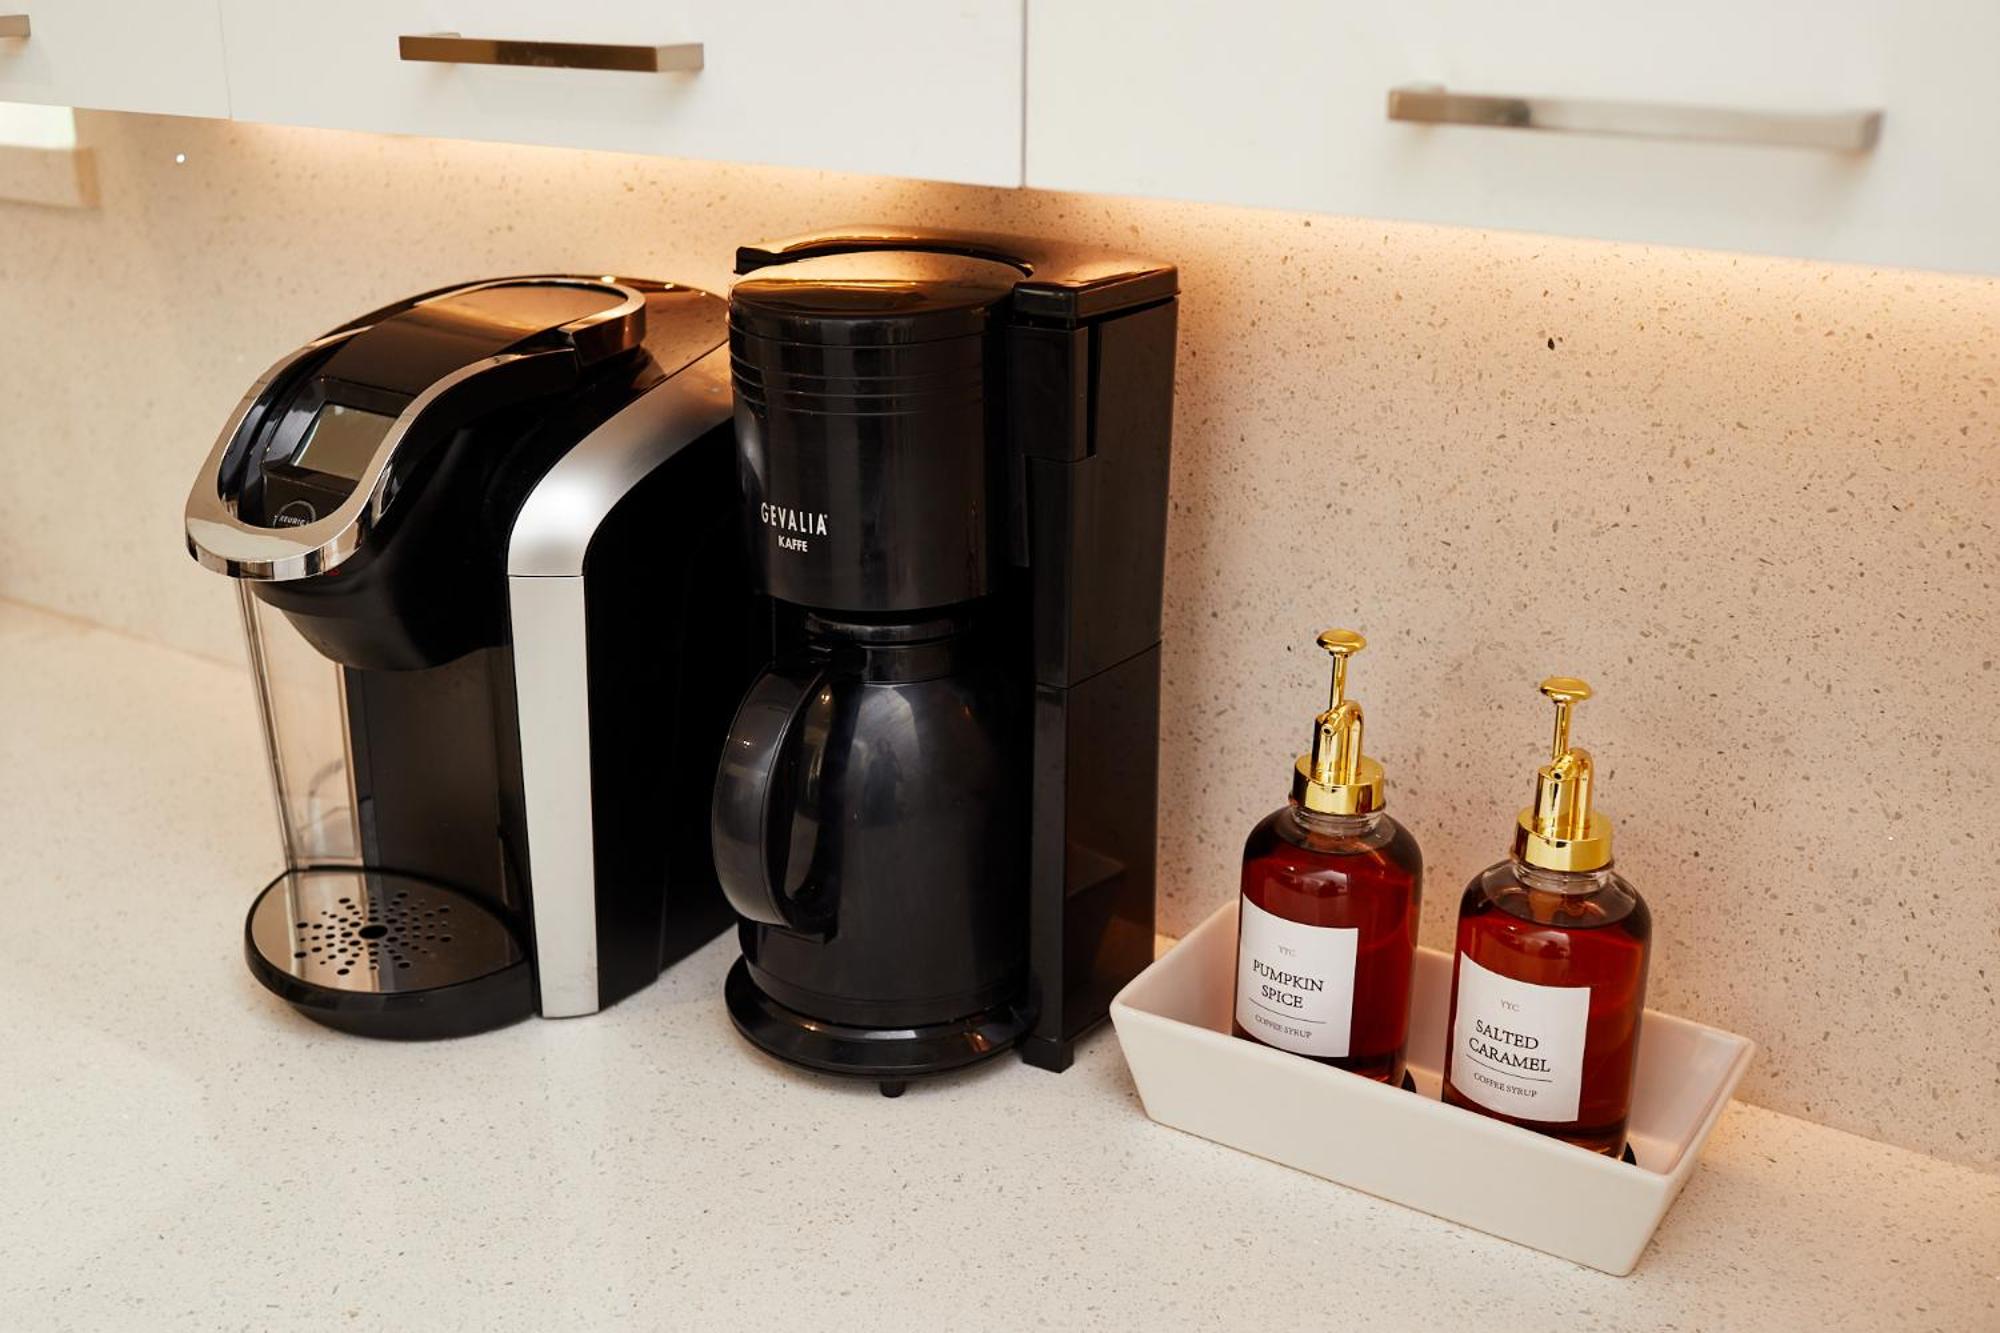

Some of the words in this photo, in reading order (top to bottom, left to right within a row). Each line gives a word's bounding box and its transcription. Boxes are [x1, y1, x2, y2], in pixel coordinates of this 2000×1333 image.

[761, 502, 827, 535] GEVALIA
[778, 535, 808, 552] KAFFE
[1253, 959, 1324, 992] PUMPKIN
[1261, 984, 1303, 1009] SPICE
[1284, 1025, 1312, 1039] SYRUP
[1475, 1019, 1539, 1049] SALTED
[1468, 1037, 1551, 1072] CARAMEL
[1473, 1072, 1505, 1091] COFFEE
[1506, 1085, 1537, 1098] SYRUP
